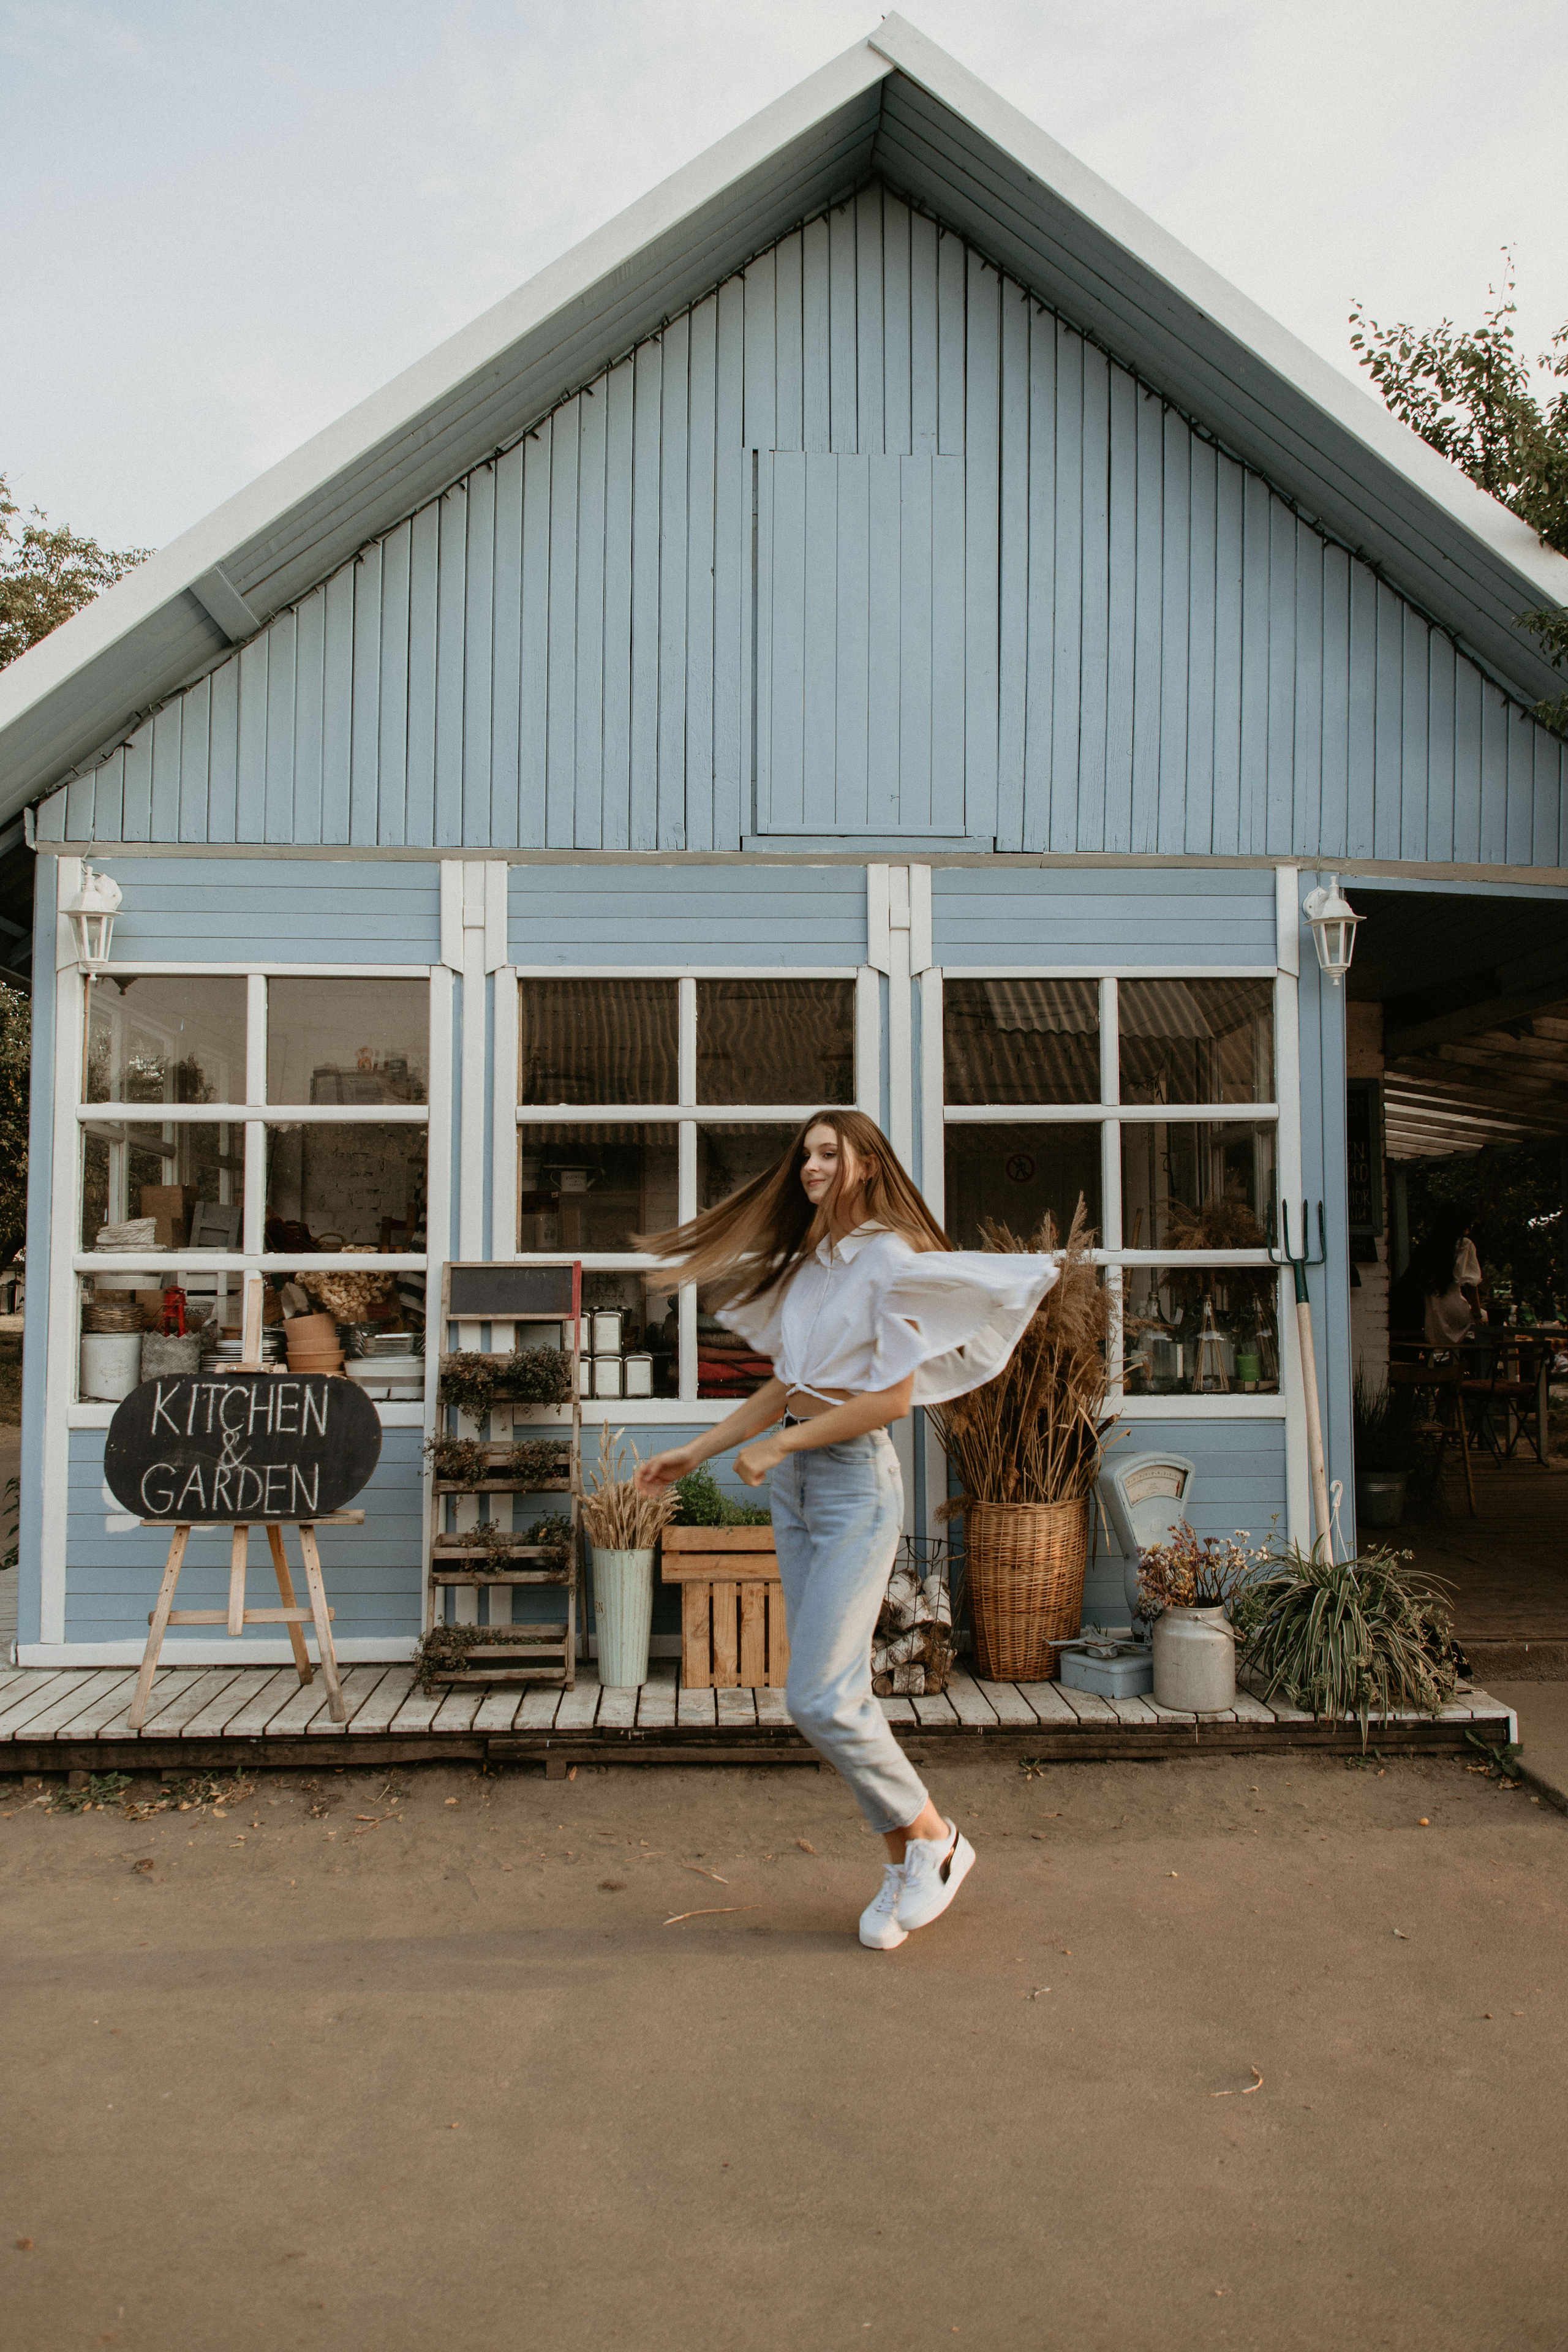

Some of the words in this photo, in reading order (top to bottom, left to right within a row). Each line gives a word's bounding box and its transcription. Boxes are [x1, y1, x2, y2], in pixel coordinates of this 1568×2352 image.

[1348, 1163, 1369, 1183] :00
[151, 1381, 329, 1437] KITCHEN
[219, 1430, 252, 1469] &
[140, 1462, 320, 1515] GARDEN
